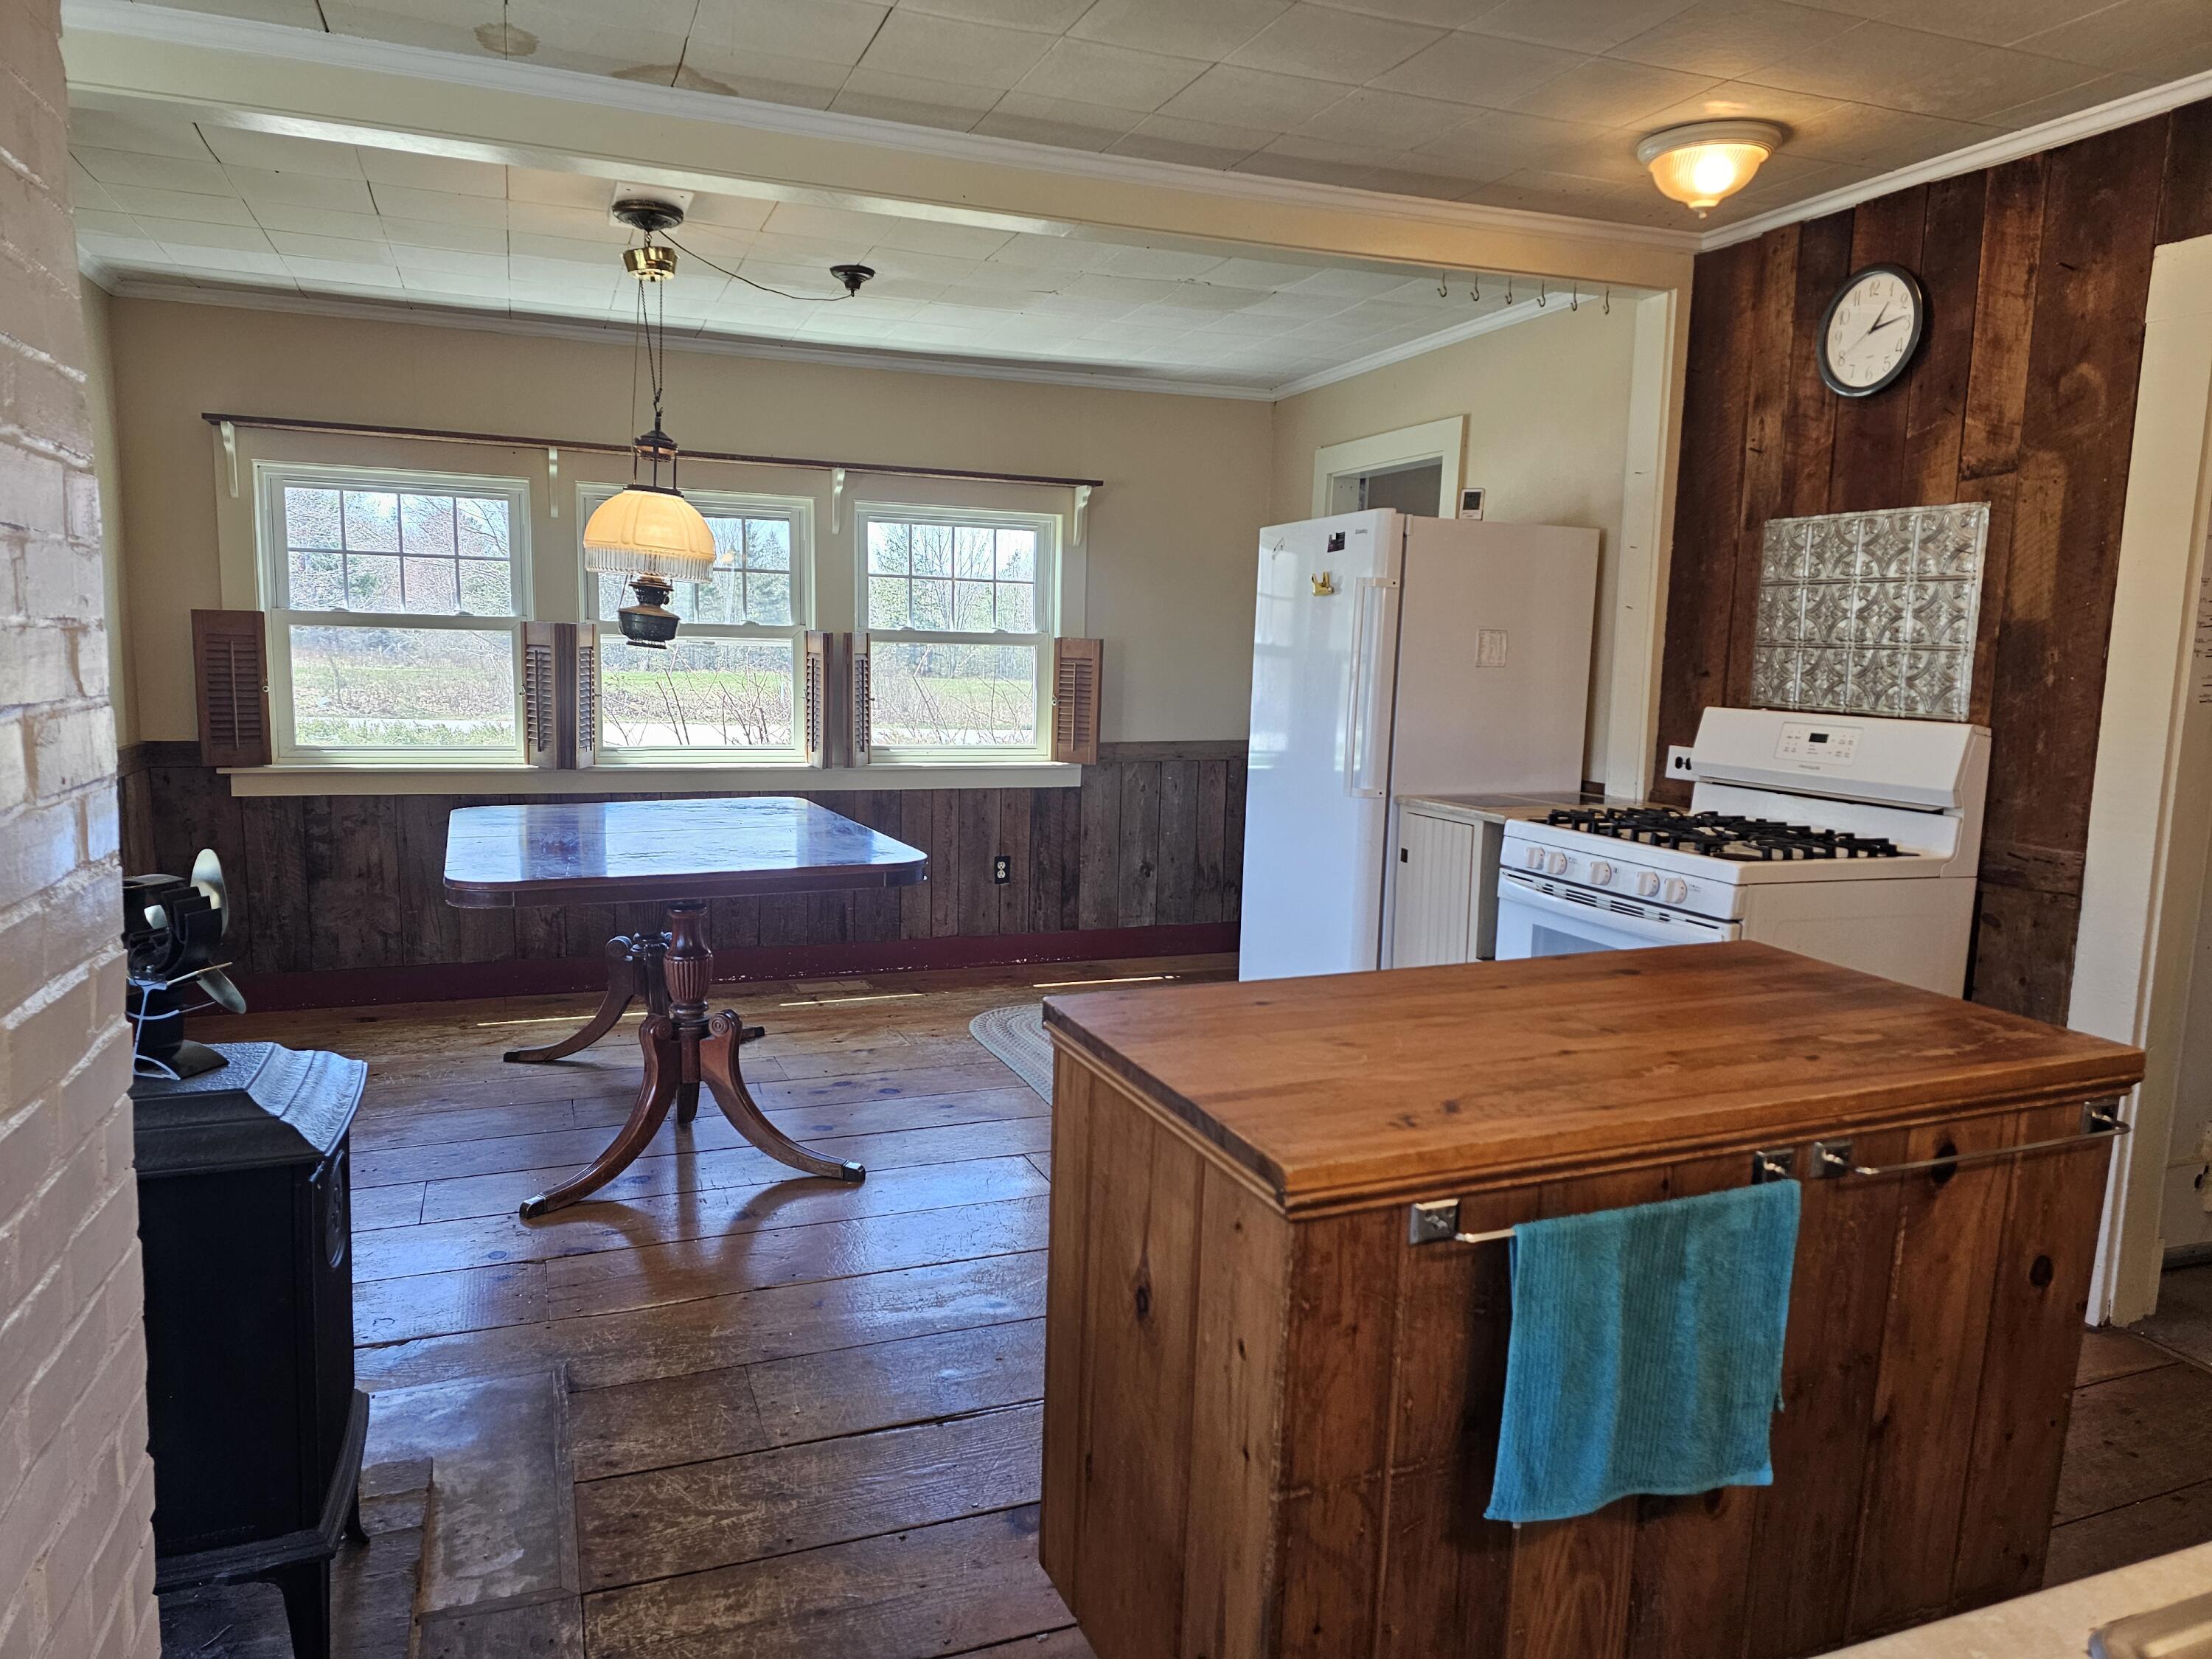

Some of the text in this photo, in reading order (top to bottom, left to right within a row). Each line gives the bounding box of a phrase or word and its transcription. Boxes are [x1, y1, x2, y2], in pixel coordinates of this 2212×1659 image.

[1869, 279, 1880, 297] 12
[1889, 282, 1894, 296] 1
[1854, 289, 1861, 306] 11
[1900, 293, 1908, 309] 2
[1840, 309, 1850, 325] 10
[1903, 314, 1910, 330] 3
[1835, 332, 1843, 347] 9
[1896, 338, 1902, 353] 4
[1838, 350, 1846, 366] 8
[1882, 356, 1891, 372] 5
[1850, 365, 1856, 378] 7
[1865, 366, 1873, 380] 6
